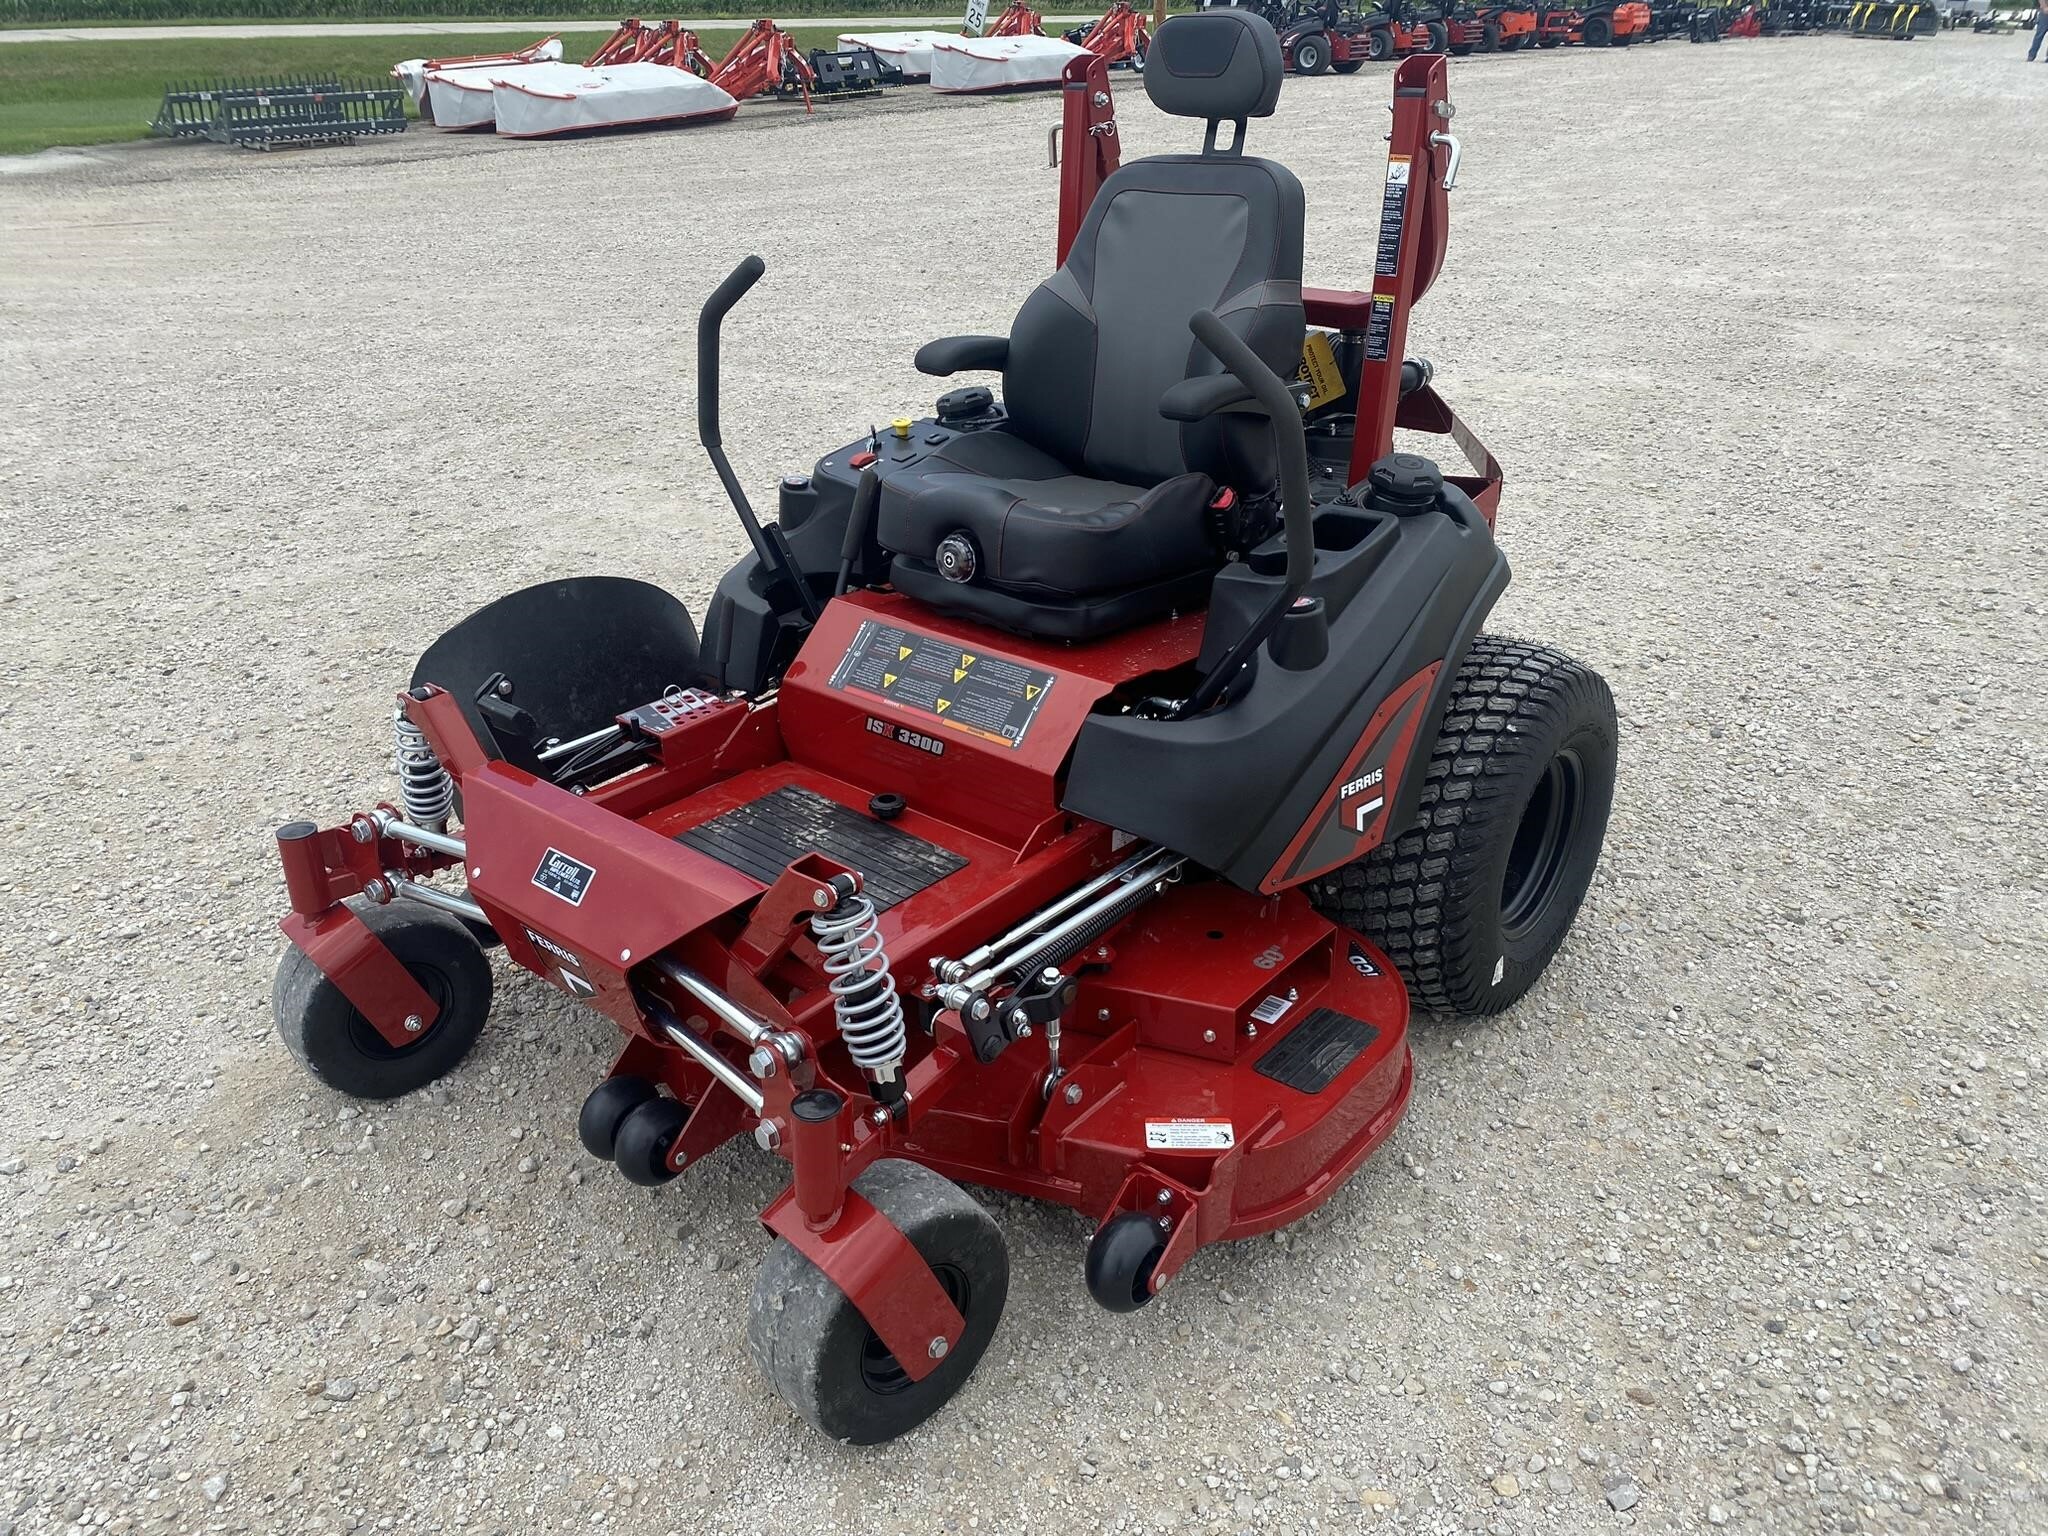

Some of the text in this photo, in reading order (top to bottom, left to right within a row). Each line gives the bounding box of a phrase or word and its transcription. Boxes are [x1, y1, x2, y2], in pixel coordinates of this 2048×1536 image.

[968, 8, 982, 28] 25
[866, 717, 944, 755] ISX 3300
[1341, 768, 1383, 799] FERRIS
[548, 853, 580, 881] Carroll
[526, 929, 580, 967] FERRIS
